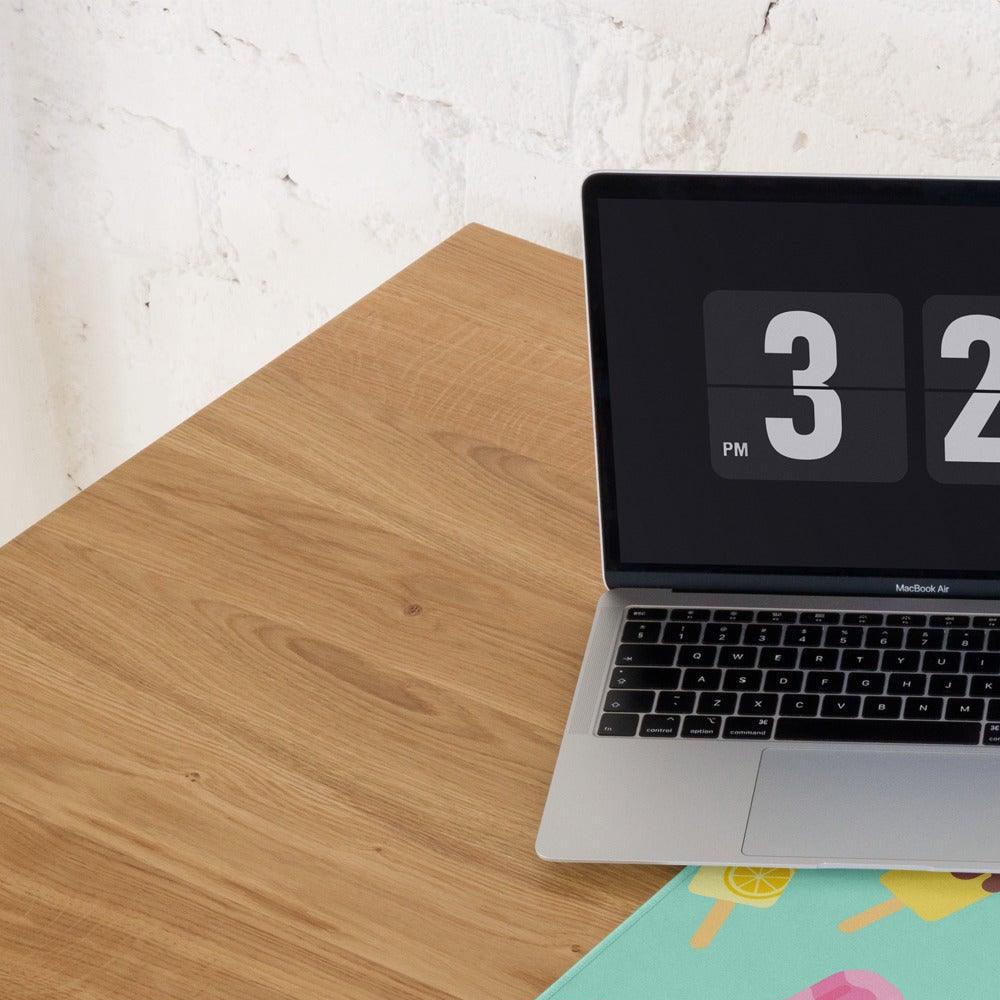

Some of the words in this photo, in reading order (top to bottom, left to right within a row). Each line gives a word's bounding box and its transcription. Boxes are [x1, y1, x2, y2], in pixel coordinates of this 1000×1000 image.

[764, 310, 842, 460] 3
[723, 441, 748, 457] PM
[896, 584, 935, 593] MacBook
[937, 585, 949, 593] Air
